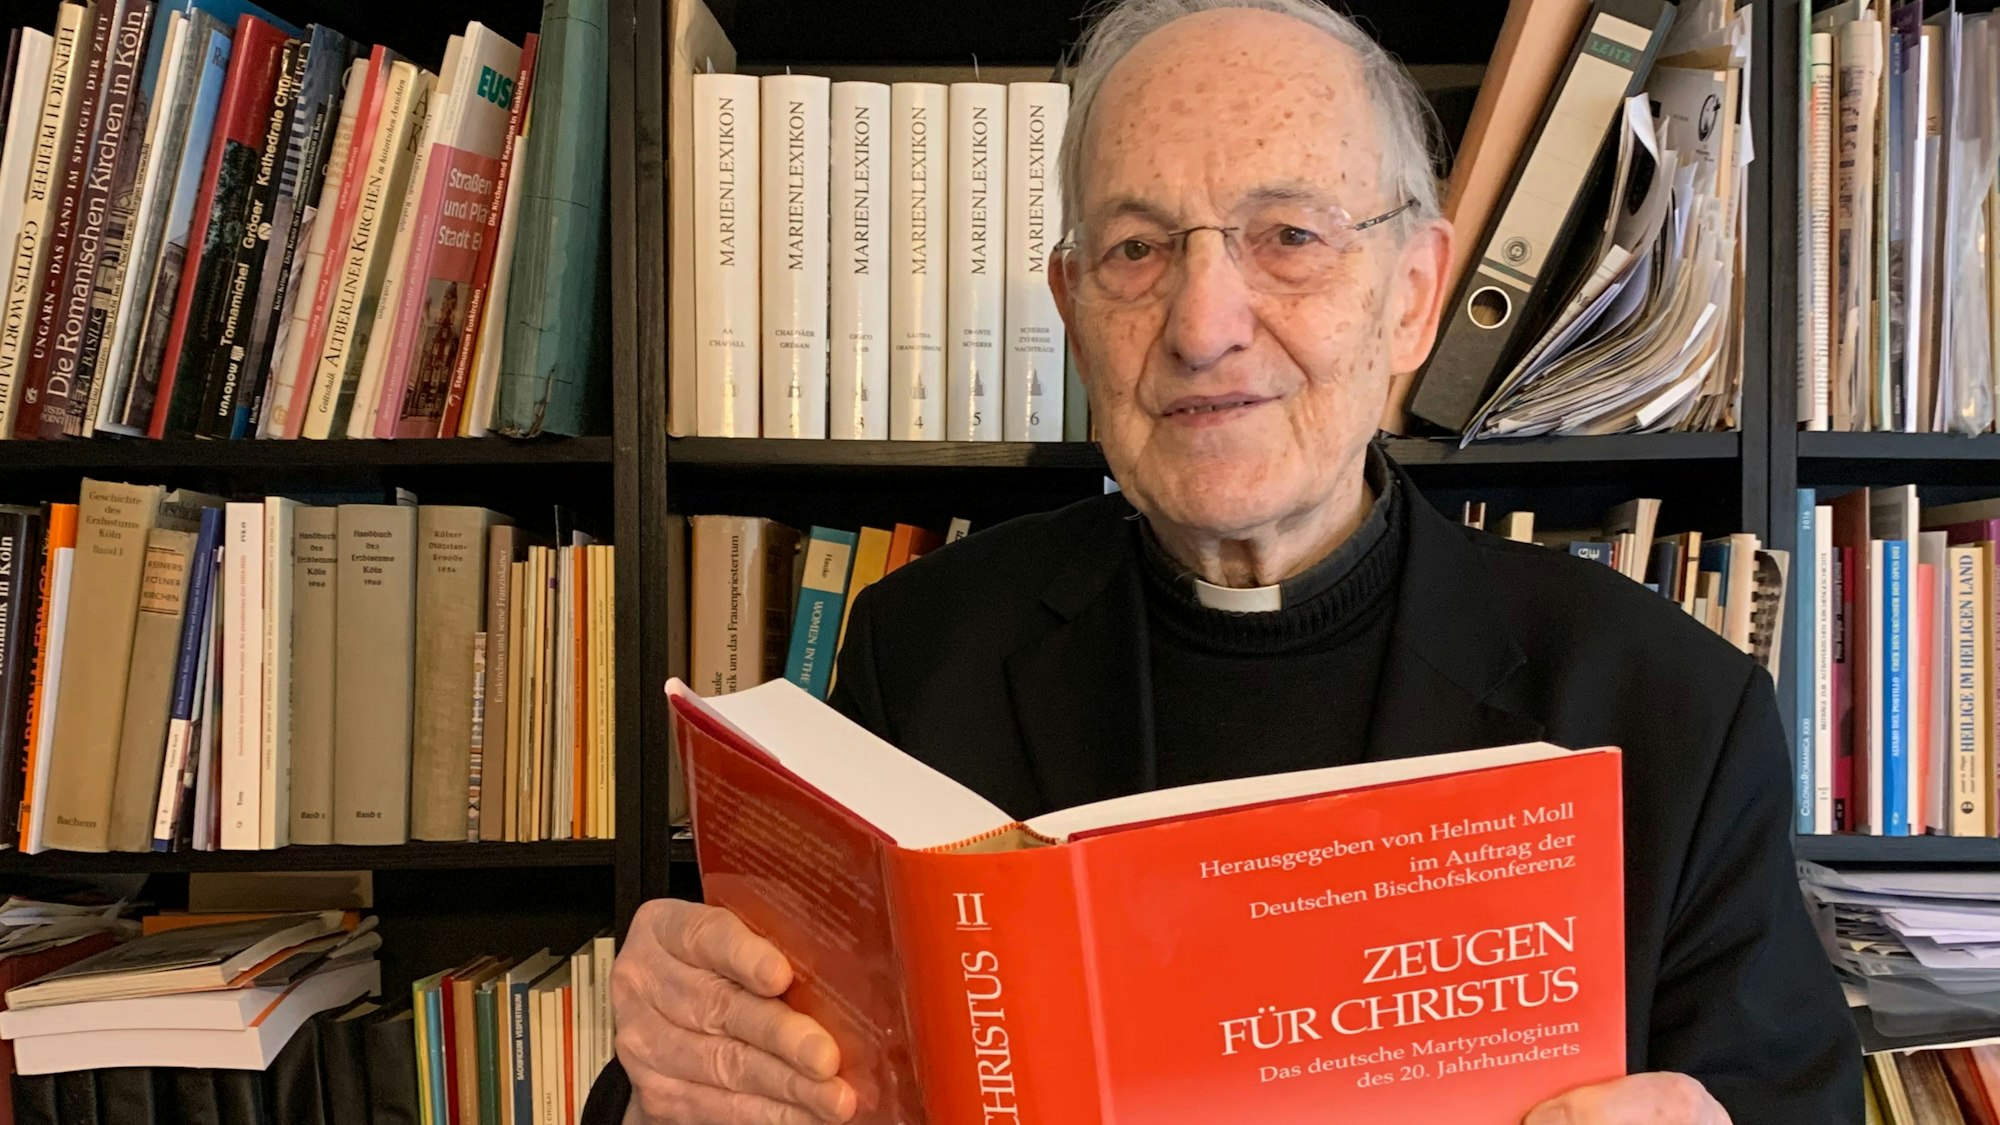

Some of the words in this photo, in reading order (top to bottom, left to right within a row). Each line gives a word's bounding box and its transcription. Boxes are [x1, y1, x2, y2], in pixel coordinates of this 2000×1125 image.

[92, 13, 108, 51] ZEIT
[113, 8, 143, 67] Köln
[1590, 41, 1633, 64] LEITZ
[44, 26, 74, 118] HEINRICH
[85, 58, 100, 90] DER
[109, 71, 130, 96] in
[477, 65, 516, 112] EUS
[389, 79, 406, 116] Ansichten
[510, 69, 528, 113] Euskirchen
[71, 96, 93, 162] SPIEGEL
[509, 115, 517, 124] in
[88, 101, 125, 192] Kirchen
[378, 119, 397, 163] historischen
[501, 124, 518, 160] Kapellen
[29, 123, 56, 201] PFEIFFER
[66, 169, 79, 189] IM
[376, 165, 385, 174] in
[497, 161, 508, 178] und
[449, 168, 493, 195] Straßen
[490, 179, 505, 210] Kirchen
[720, 97, 735, 267] MARIENLEXIKON
[788, 101, 804, 271] MARIENLEXIKON
[854, 106, 869, 275] MARIENLEXIKON
[912, 106, 927, 275] MARIENLEXIKON
[972, 106, 987, 275] MARIENLEXIKON
[1029, 104, 1044, 273] MARIENLEXIKON
[57, 195, 74, 237] LAND
[350, 174, 382, 251] KIRCHEN
[444, 199, 468, 219] und
[488, 211, 497, 226] Die
[219, 261, 250, 347] Tomamichel
[256, 108, 284, 186] Kathedrale
[438, 225, 470, 249] Stadt
[13, 219, 38, 294] GOTTES
[50, 244, 65, 273] DAS
[54, 195, 108, 353] Romanischen
[2, 298, 24, 351] WORT
[33, 291, 56, 358] UNGARN
[322, 255, 363, 367] ALTBERLINER
[452, 333, 472, 388] Stadtmuseum
[464, 288, 482, 332] Euskirchen
[46, 355, 75, 397] Die
[216, 362, 240, 416] motovun
[914, 415, 924, 429] 4
[973, 412, 982, 426] 5
[1030, 412, 1040, 426] 6
[89, 491, 142, 505] Geschichte
[105, 506, 121, 515] des
[86, 515, 139, 528] Erzbistums
[99, 529, 121, 539] Köln
[299, 532, 336, 540] Handbuch
[353, 530, 392, 538] Handbuch
[297, 556, 338, 564] Erzbistums
[351, 554, 395, 562] Erzbistums
[1891, 545, 1899, 558] DEI
[1891, 560, 1899, 579] OPUS
[307, 568, 326, 576] Köln
[363, 566, 382, 574] Köln
[496, 549, 507, 606] Franziskaner
[727, 535, 742, 631] Frauenpriestertum
[1891, 581, 1899, 595] DES
[1959, 555, 1973, 595] LAND
[496, 608, 505, 630] seine
[808, 601, 824, 644] WOMEN
[1959, 600, 1974, 668] HEILIGEN
[495, 633, 505, 650] und
[727, 634, 738, 655] das
[804, 647, 816, 660] IN
[1891, 635, 1899, 649] DEN
[494, 653, 505, 702] Euskirchen
[729, 656, 737, 671] um
[800, 661, 814, 685] THE
[1959, 672, 1974, 688] IM
[1891, 677, 1899, 711] PORTILLO
[1891, 714, 1899, 728] DEL
[1959, 692, 1974, 752] HEILIGE
[56, 815, 97, 829] Bachem
[1200, 836, 1375, 879] Herausgegeben
[1381, 829, 1424, 848] von
[1429, 814, 1516, 842] Helmut
[1522, 801, 1575, 825] Moll
[1409, 854, 1439, 873] im
[1445, 839, 1532, 868] Auftrag
[1538, 831, 1576, 852] der
[1249, 887, 1368, 919] Deutschen
[1373, 853, 1576, 900] Bischofskonferenz
[953, 893, 988, 927] II
[1362, 916, 1577, 985] ZEUGEN
[514, 993, 524, 1038] VESPERTINUM
[1219, 1005, 1322, 1057] FÜR
[1331, 966, 1580, 1036] CHRISTUS
[1259, 1064, 1301, 1083] Das
[1307, 1044, 1405, 1073] deutsche
[1411, 1019, 1580, 1061] Martyrologium
[1356, 1071, 1393, 1090] des
[1400, 1063, 1431, 1083] 20.
[1436, 1042, 1580, 1080] Jahrhunderts
